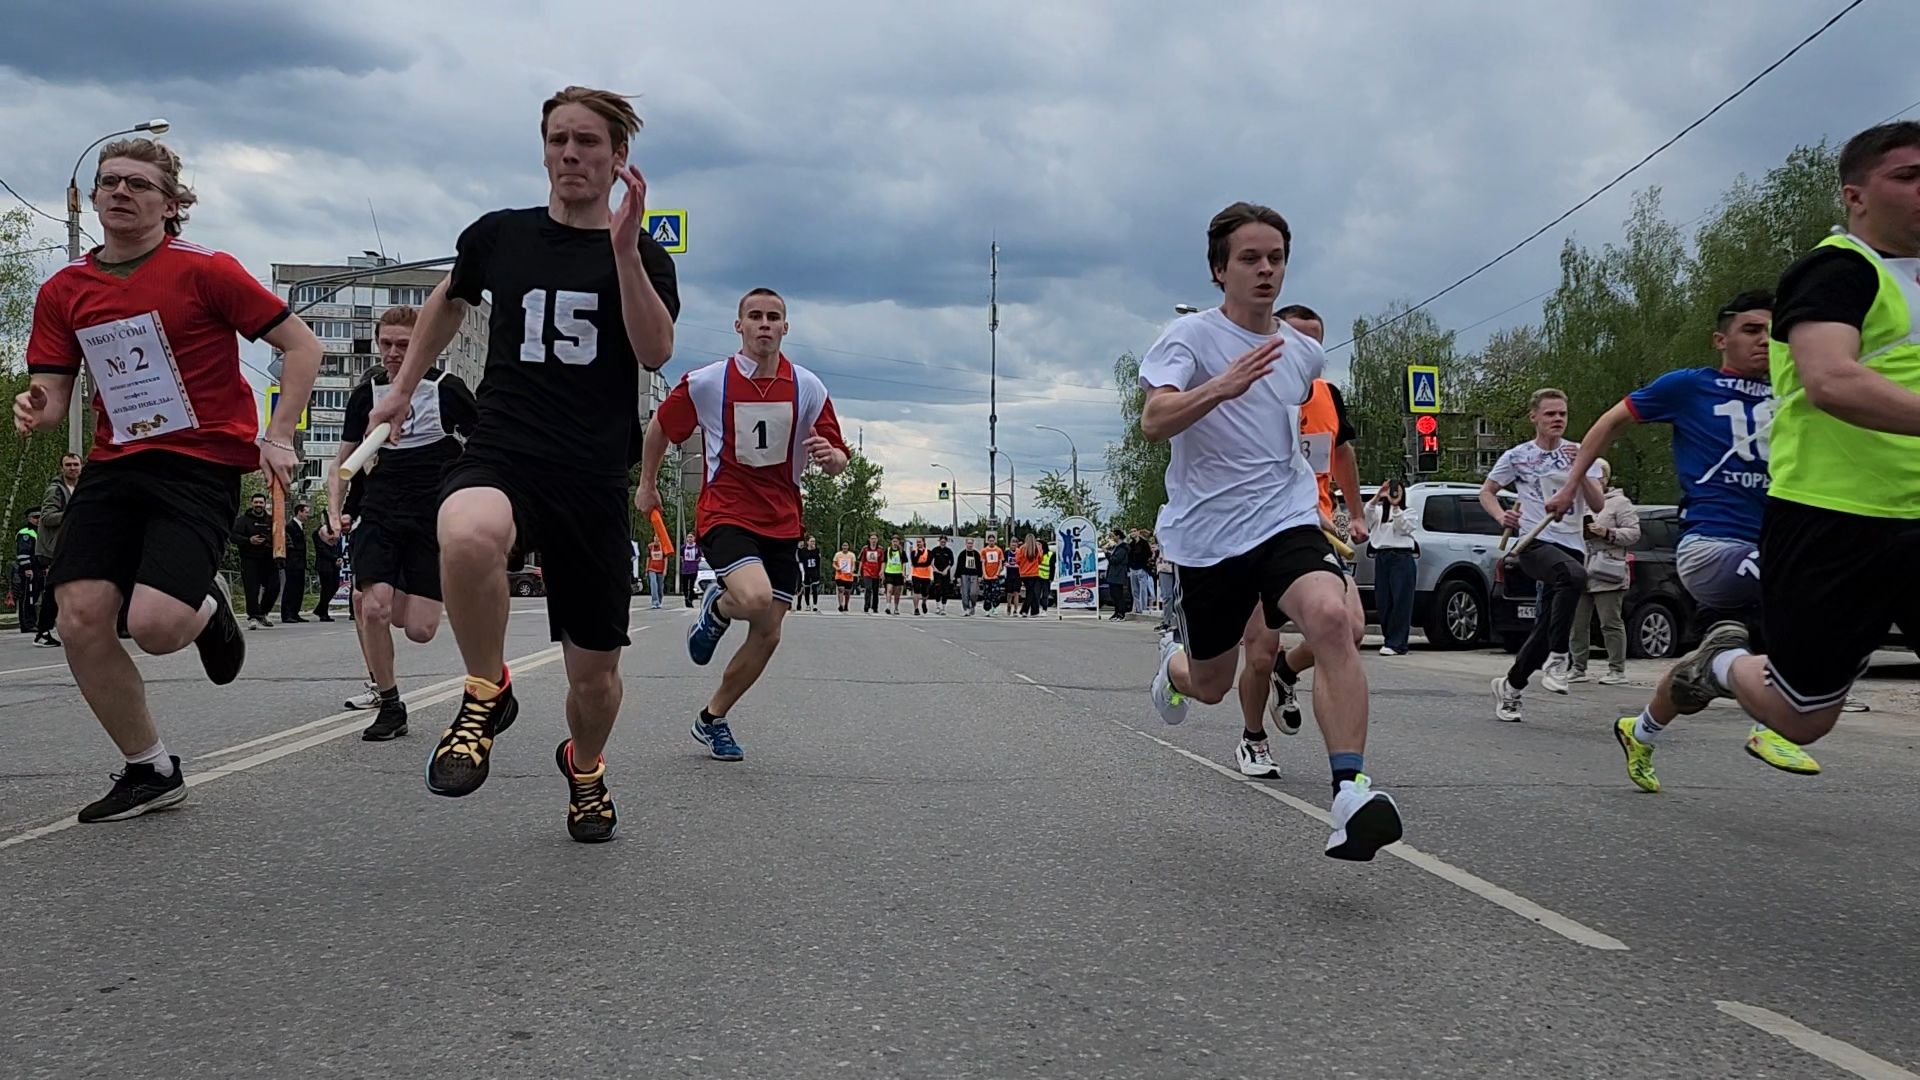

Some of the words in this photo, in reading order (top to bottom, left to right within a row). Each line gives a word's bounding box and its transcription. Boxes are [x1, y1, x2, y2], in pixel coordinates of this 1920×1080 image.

[85, 332, 117, 347] МБОУ
[118, 325, 147, 339] СОШ
[520, 288, 598, 365] 15
[105, 356, 127, 378] №
[129, 346, 149, 371] 2
[752, 420, 768, 449] 1
[1424, 435, 1438, 451] 14
[807, 558, 816, 567] 15
[1072, 526, 1082, 585] СТАРТ
